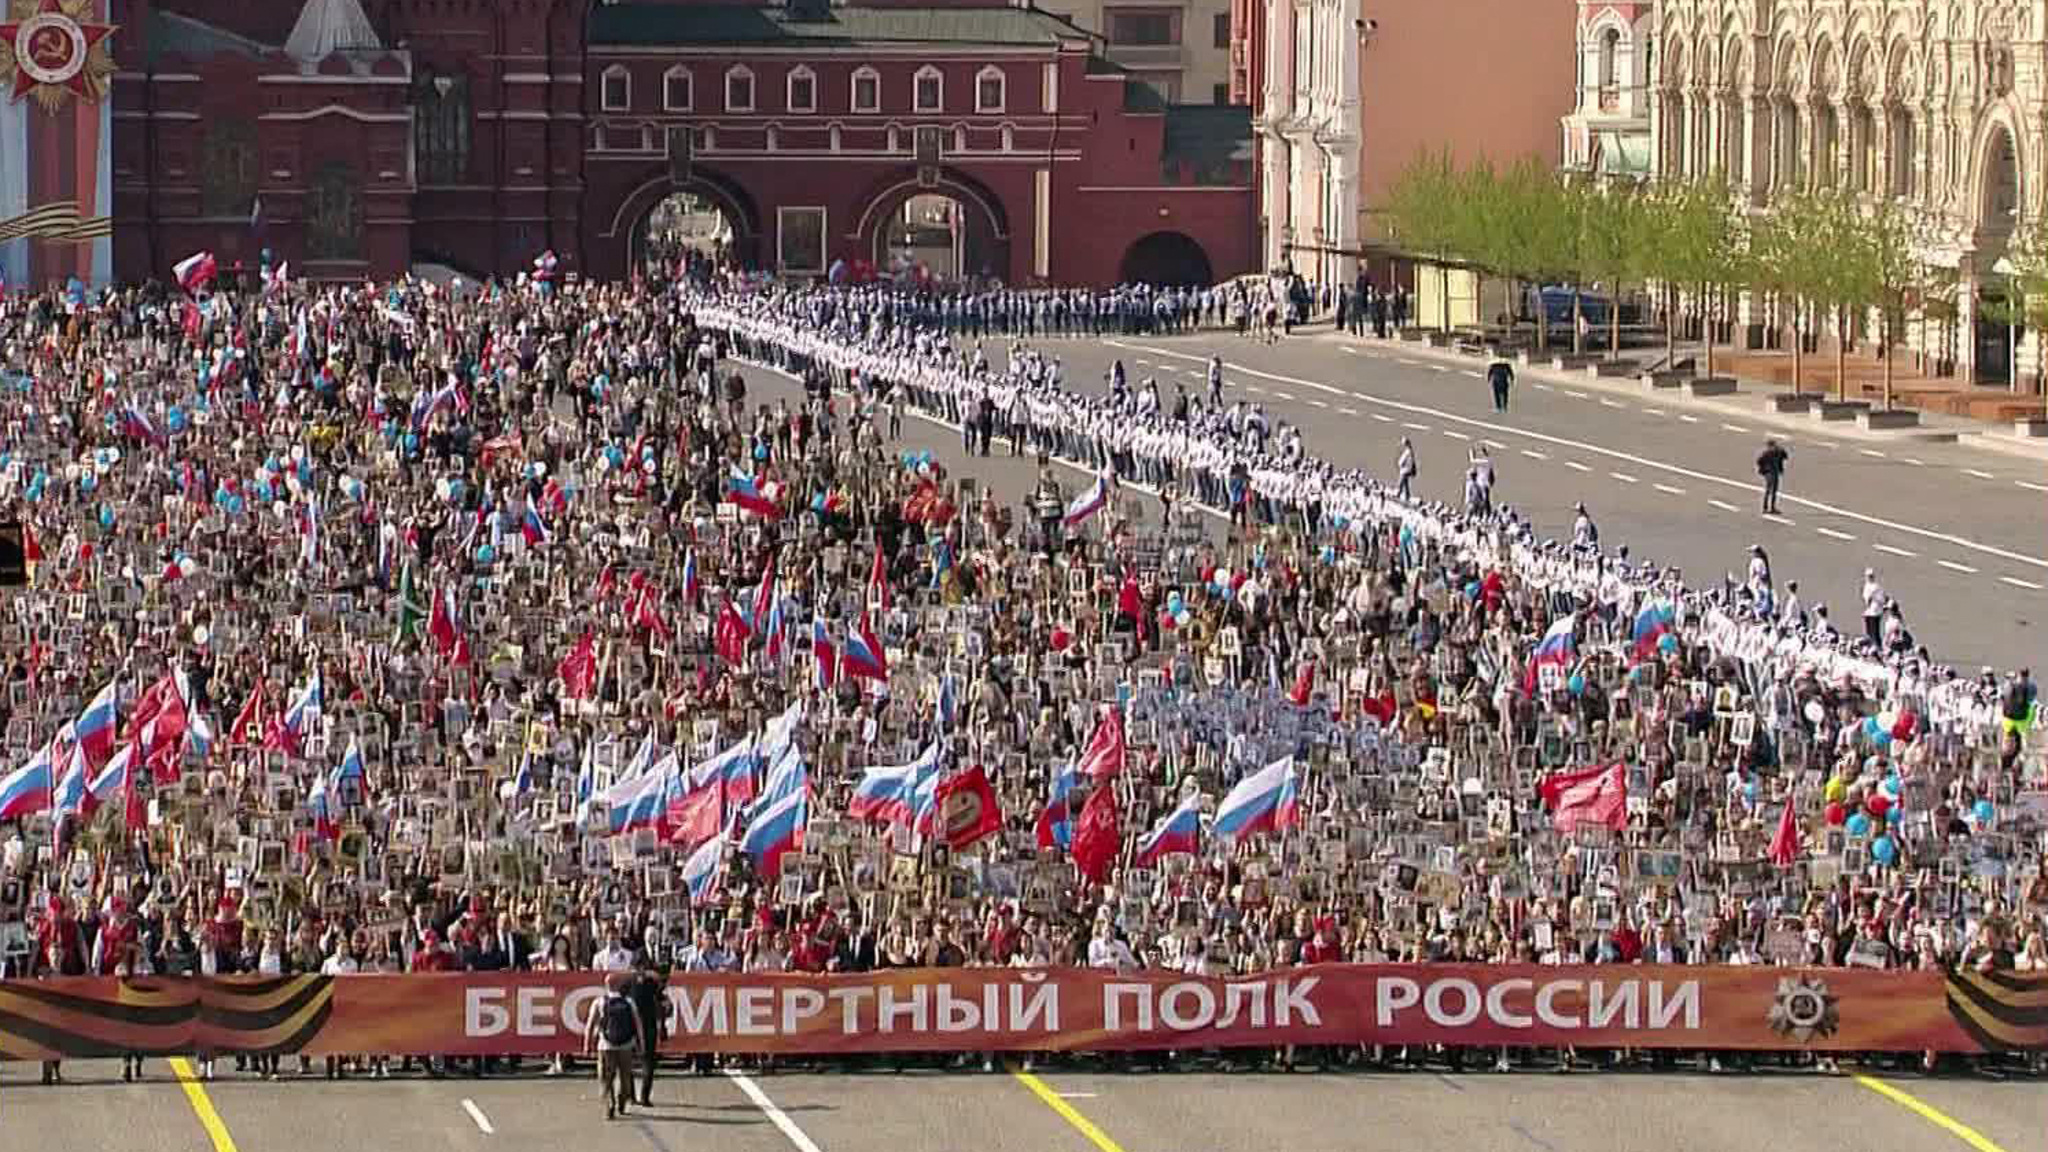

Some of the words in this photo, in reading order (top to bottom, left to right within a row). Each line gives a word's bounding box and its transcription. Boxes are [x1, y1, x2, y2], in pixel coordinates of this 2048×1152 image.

[465, 971, 1060, 1037] БЕСМЕРТНЫЙ
[1103, 976, 1322, 1031] ПОЛК
[1376, 977, 1700, 1030] РОССИИ
